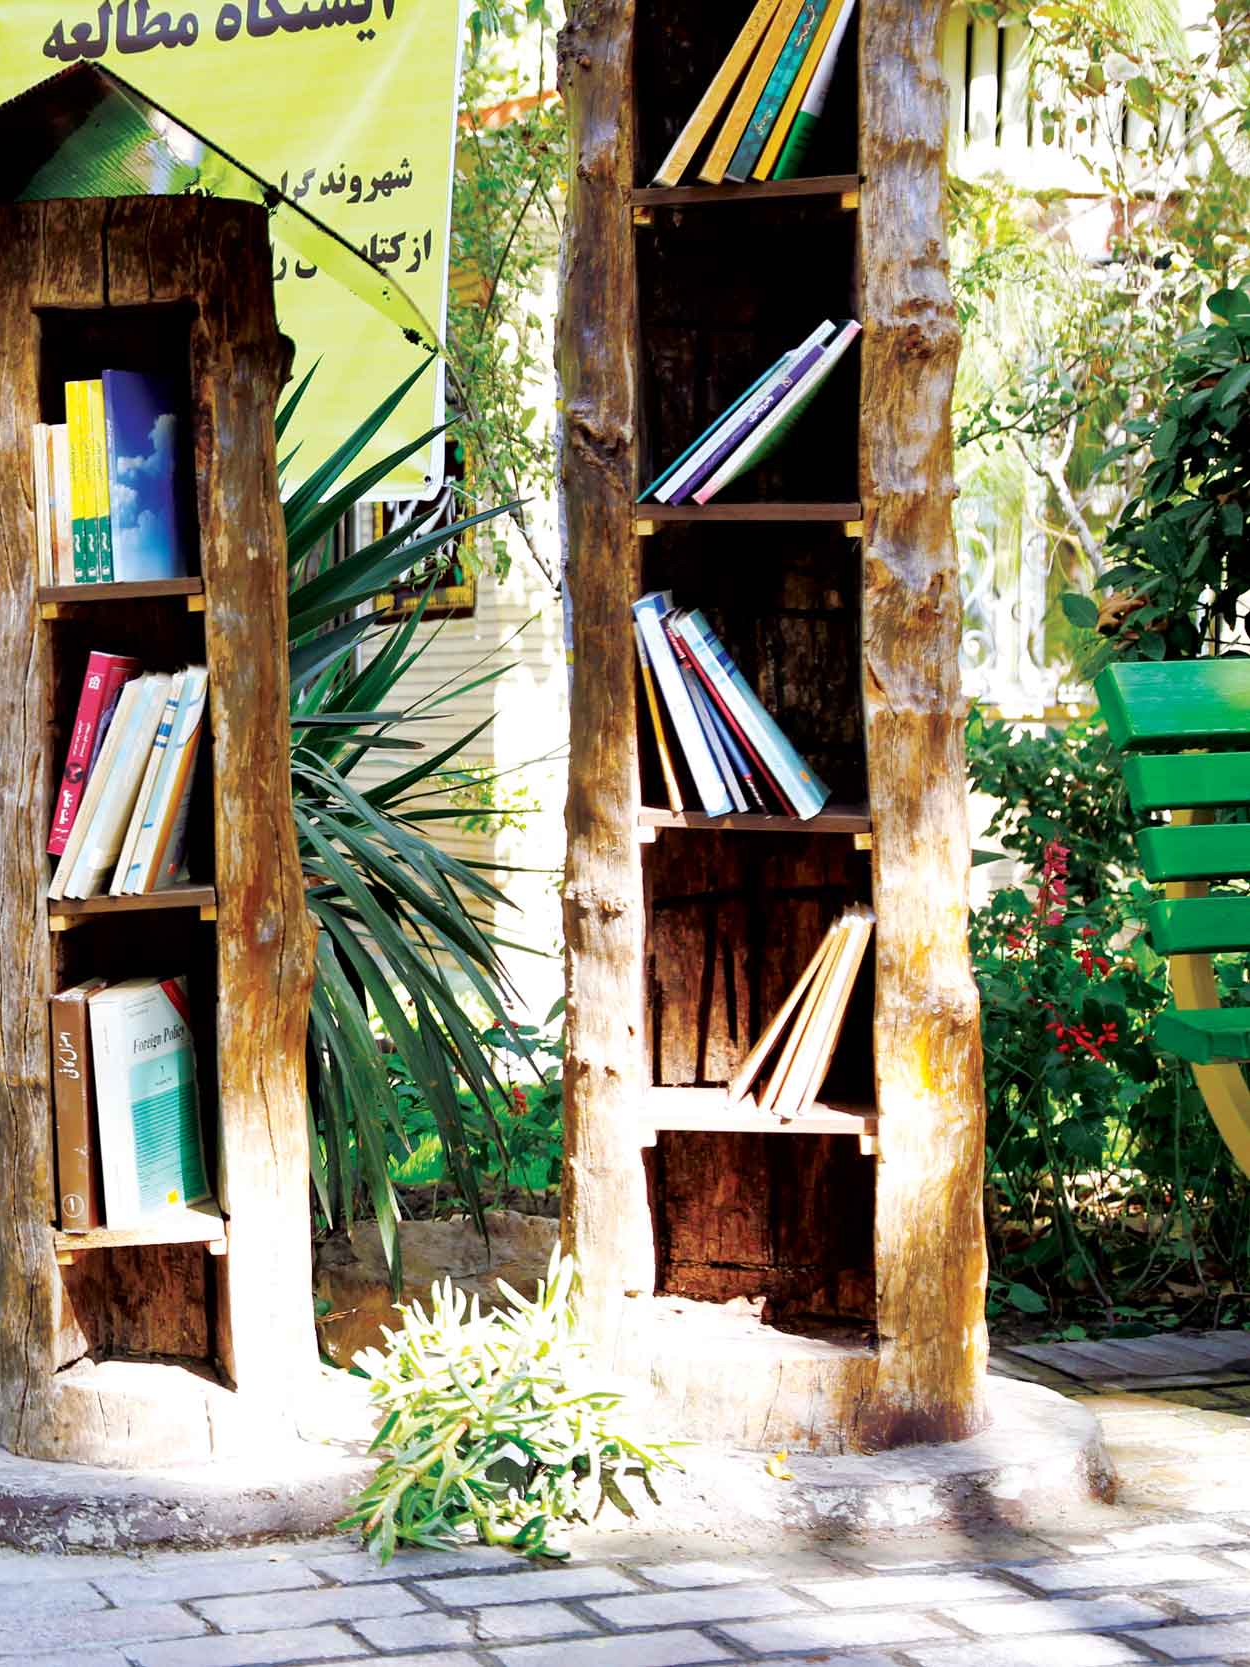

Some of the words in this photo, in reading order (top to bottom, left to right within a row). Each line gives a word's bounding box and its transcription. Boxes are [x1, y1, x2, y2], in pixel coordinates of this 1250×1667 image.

[43, 0, 199, 61] مطالعه
[281, 168, 316, 204] گرا
[320, 158, 413, 204] شهروند
[359, 232, 407, 264] کتا
[406, 230, 432, 273] از
[133, 1033, 162, 1054] Foreign
